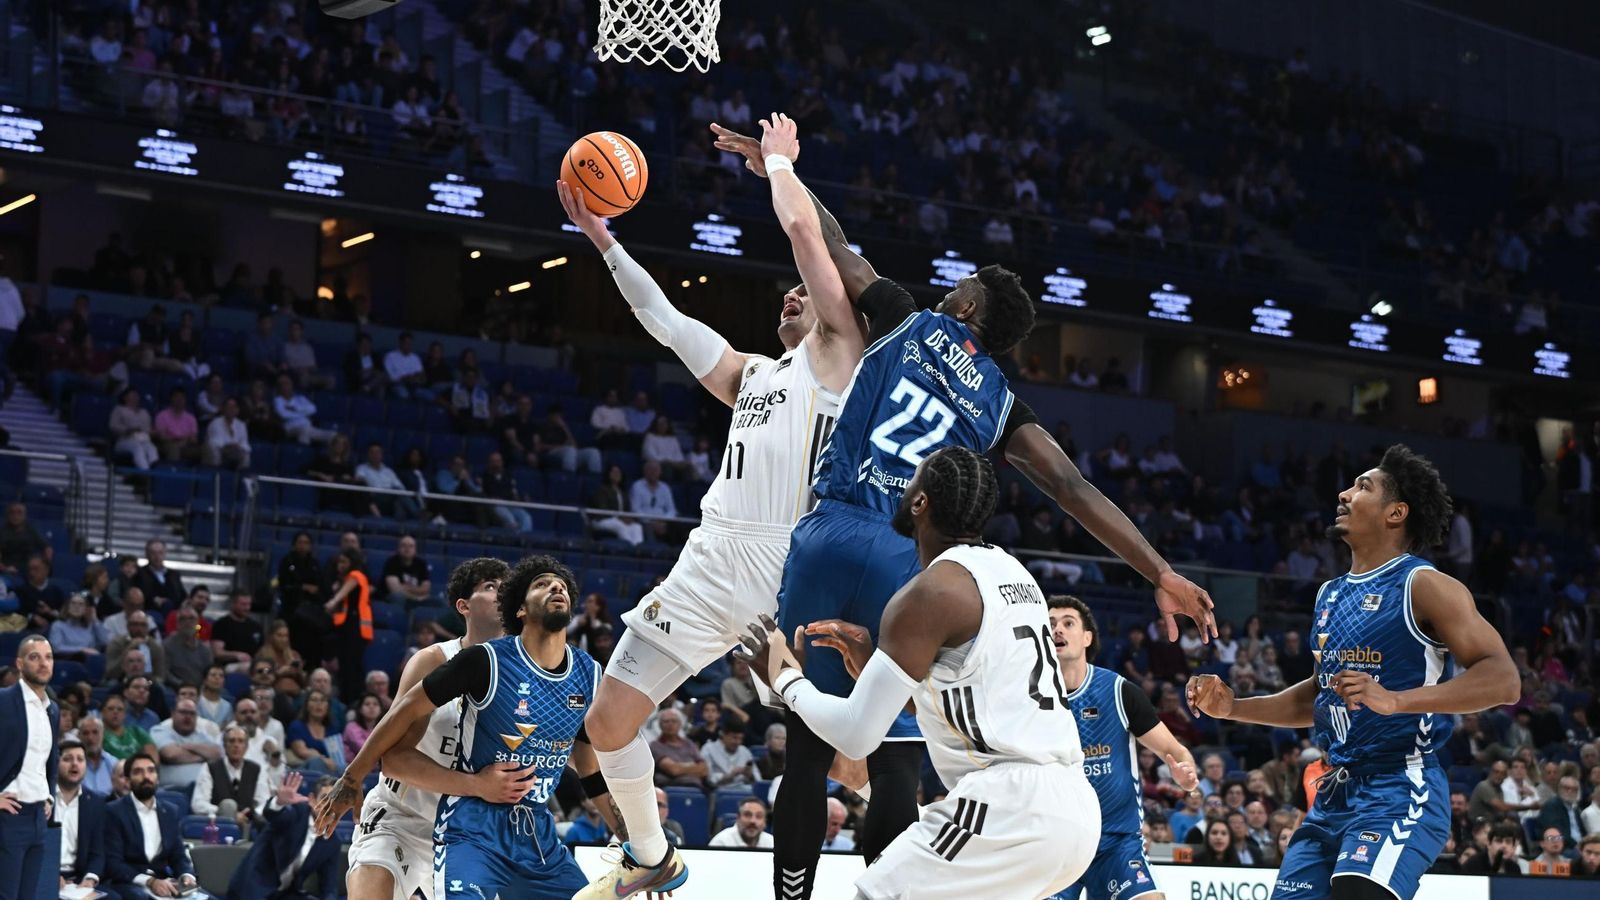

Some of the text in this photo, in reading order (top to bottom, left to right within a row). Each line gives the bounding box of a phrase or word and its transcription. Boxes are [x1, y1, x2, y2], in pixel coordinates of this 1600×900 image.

[600, 132, 637, 181] Wilson
[587, 159, 605, 180] acb
[924, 328, 950, 352] DE
[941, 342, 984, 391] SOUSA
[958, 397, 983, 418] salud
[869, 376, 958, 467] 22
[725, 441, 745, 480] 11
[871, 465, 911, 489] Cajaru
[998, 583, 1042, 606] FERNANDO
[510, 752, 571, 769] BURGO
[1083, 743, 1112, 757] ablo
[1191, 880, 1269, 900] BANCO
